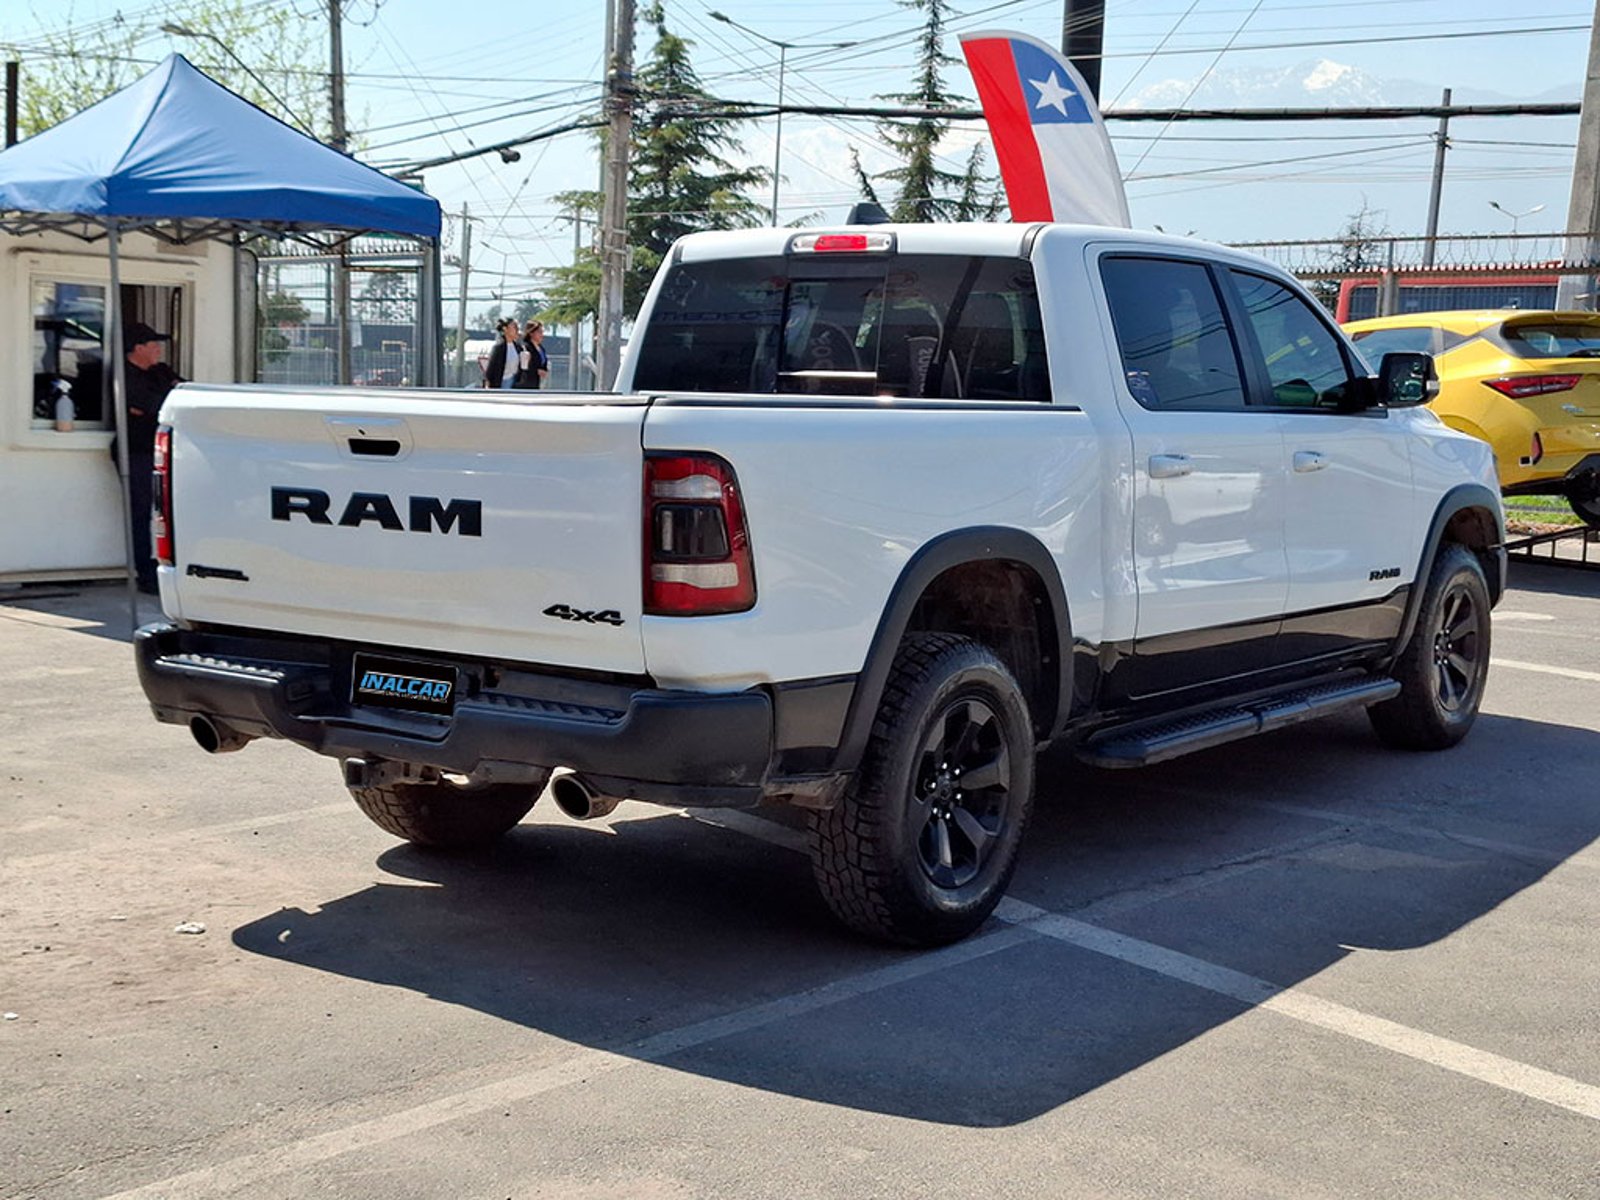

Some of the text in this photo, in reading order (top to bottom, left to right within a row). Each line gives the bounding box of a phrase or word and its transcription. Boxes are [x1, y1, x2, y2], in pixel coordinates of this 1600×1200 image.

[271, 486, 482, 537] RAM
[542, 603, 626, 626] 4x4
[360, 673, 449, 699] INALCAR
